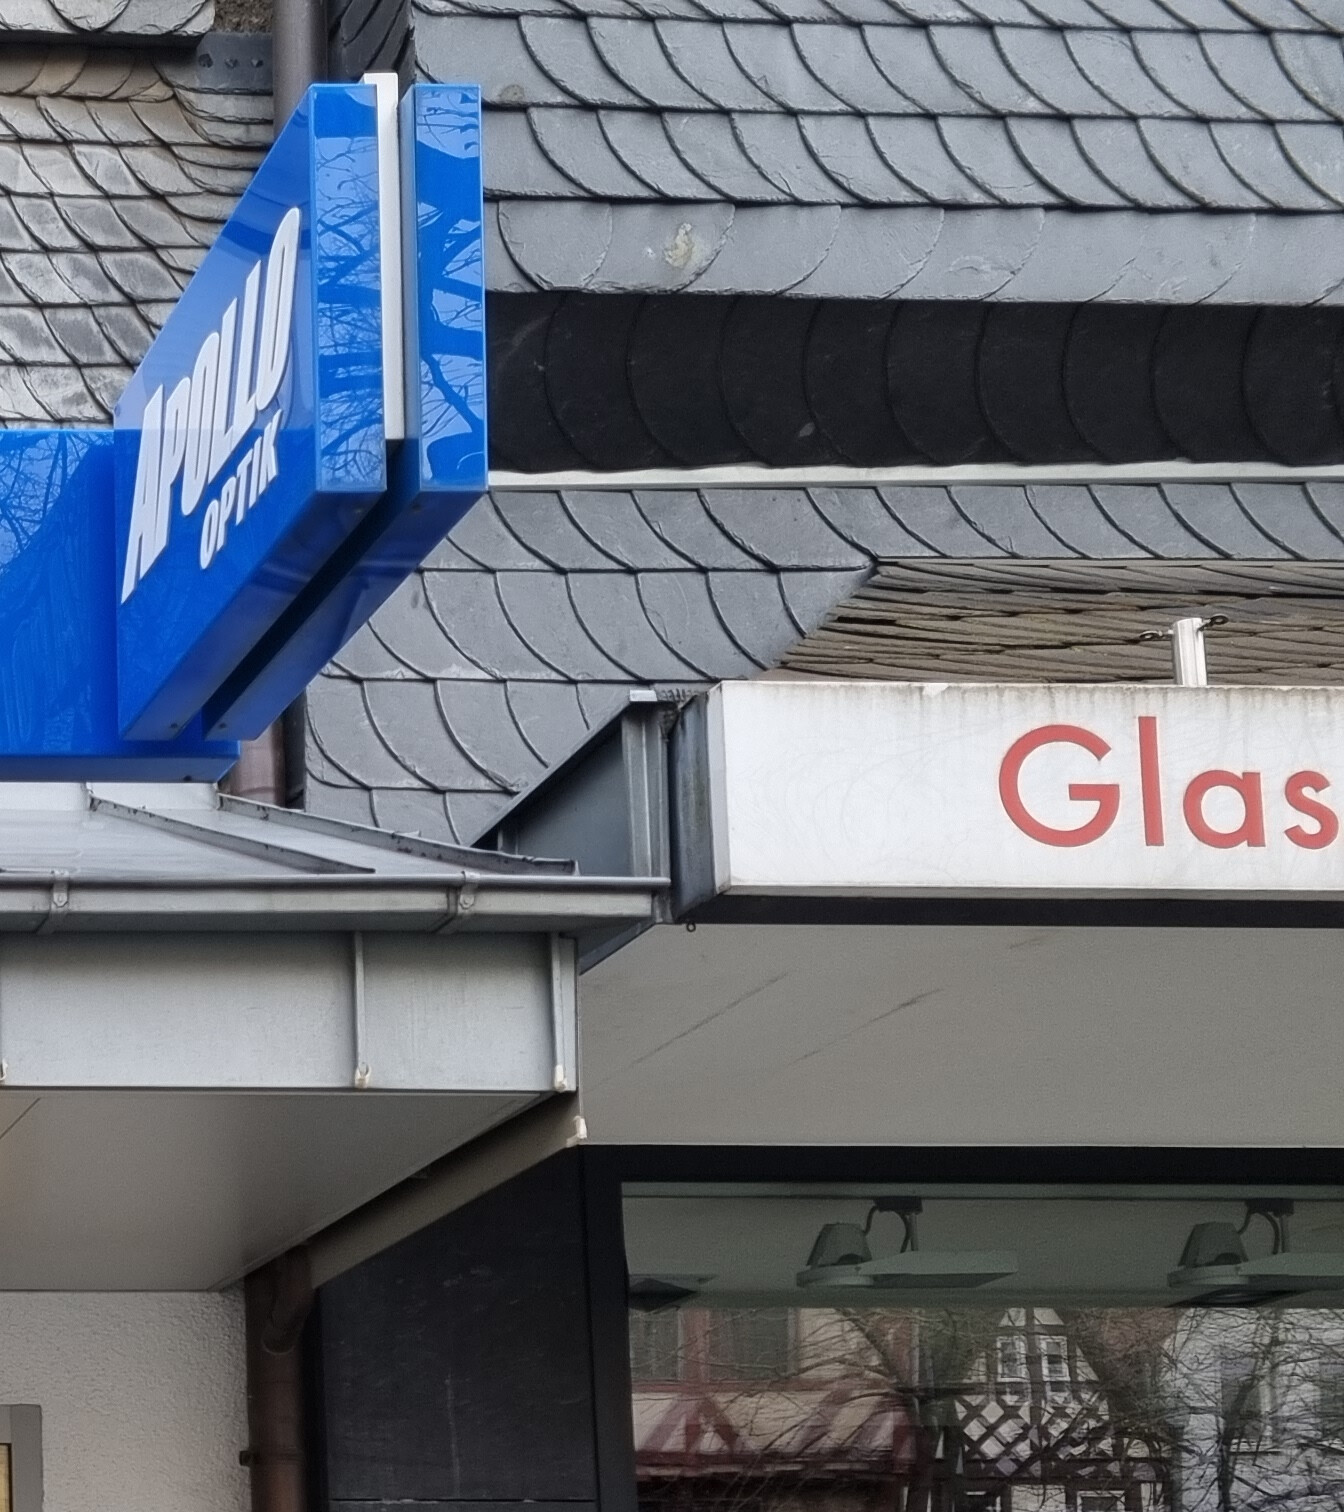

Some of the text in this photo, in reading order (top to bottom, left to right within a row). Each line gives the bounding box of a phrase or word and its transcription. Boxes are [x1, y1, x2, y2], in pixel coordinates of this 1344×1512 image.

[120, 208, 300, 604] APOLLO
[200, 409, 282, 570] OPTIK
[998, 716, 1339, 850] Glas
